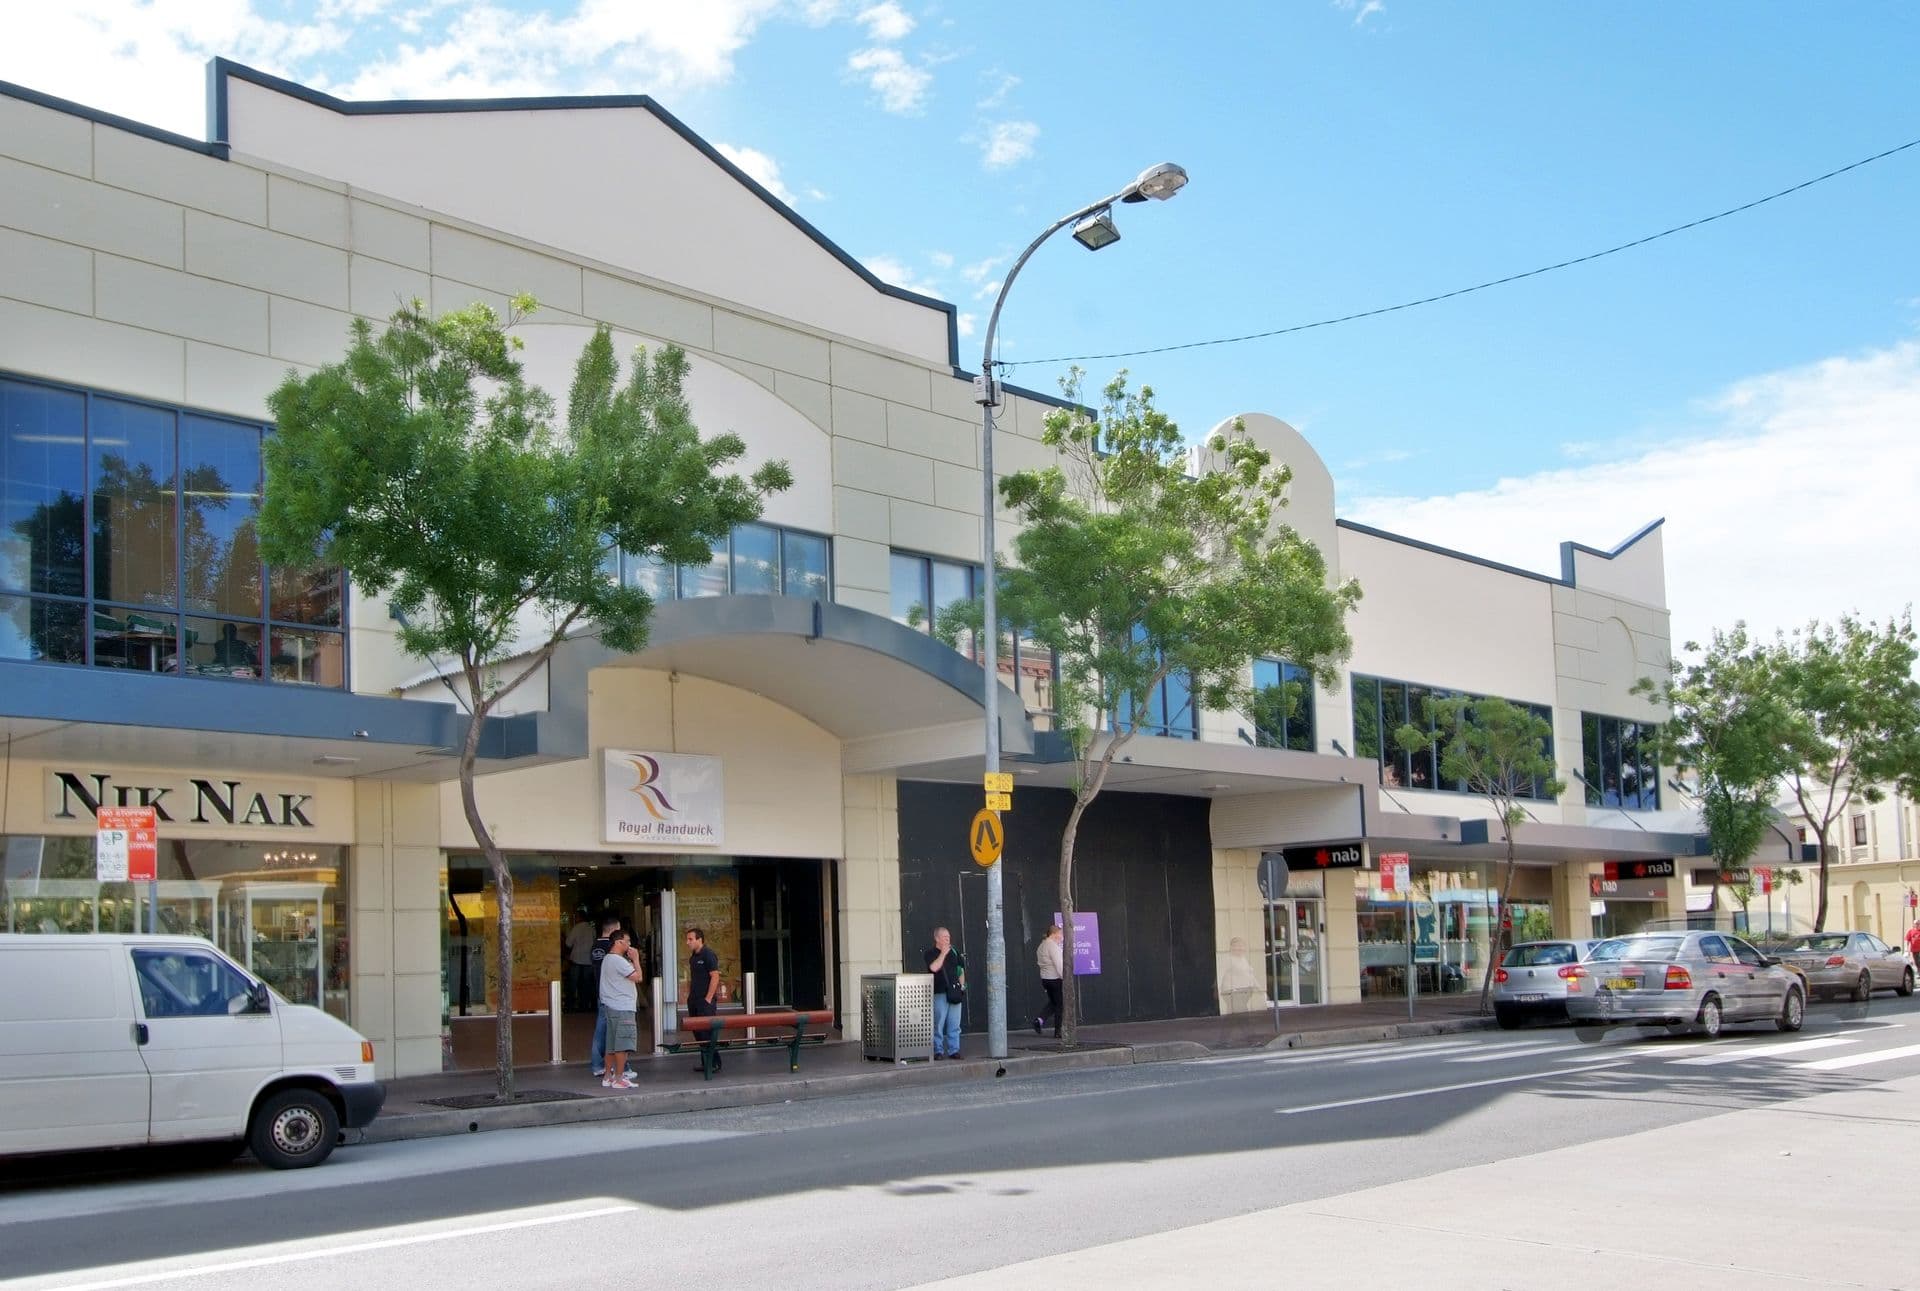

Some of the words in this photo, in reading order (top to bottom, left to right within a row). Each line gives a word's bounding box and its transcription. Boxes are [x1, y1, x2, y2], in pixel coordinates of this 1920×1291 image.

[55, 772, 176, 822] NIK
[190, 779, 315, 827] NAK
[101, 809, 113, 817] NO
[116, 809, 153, 817] STOPPING
[618, 821, 653, 836] Royal
[657, 822, 714, 837] Randwick
[136, 831, 149, 841] NO
[1332, 847, 1360, 863] nab
[1648, 861, 1672, 874] nab
[1731, 871, 1749, 882] nab
[1602, 879, 1618, 892] nab
